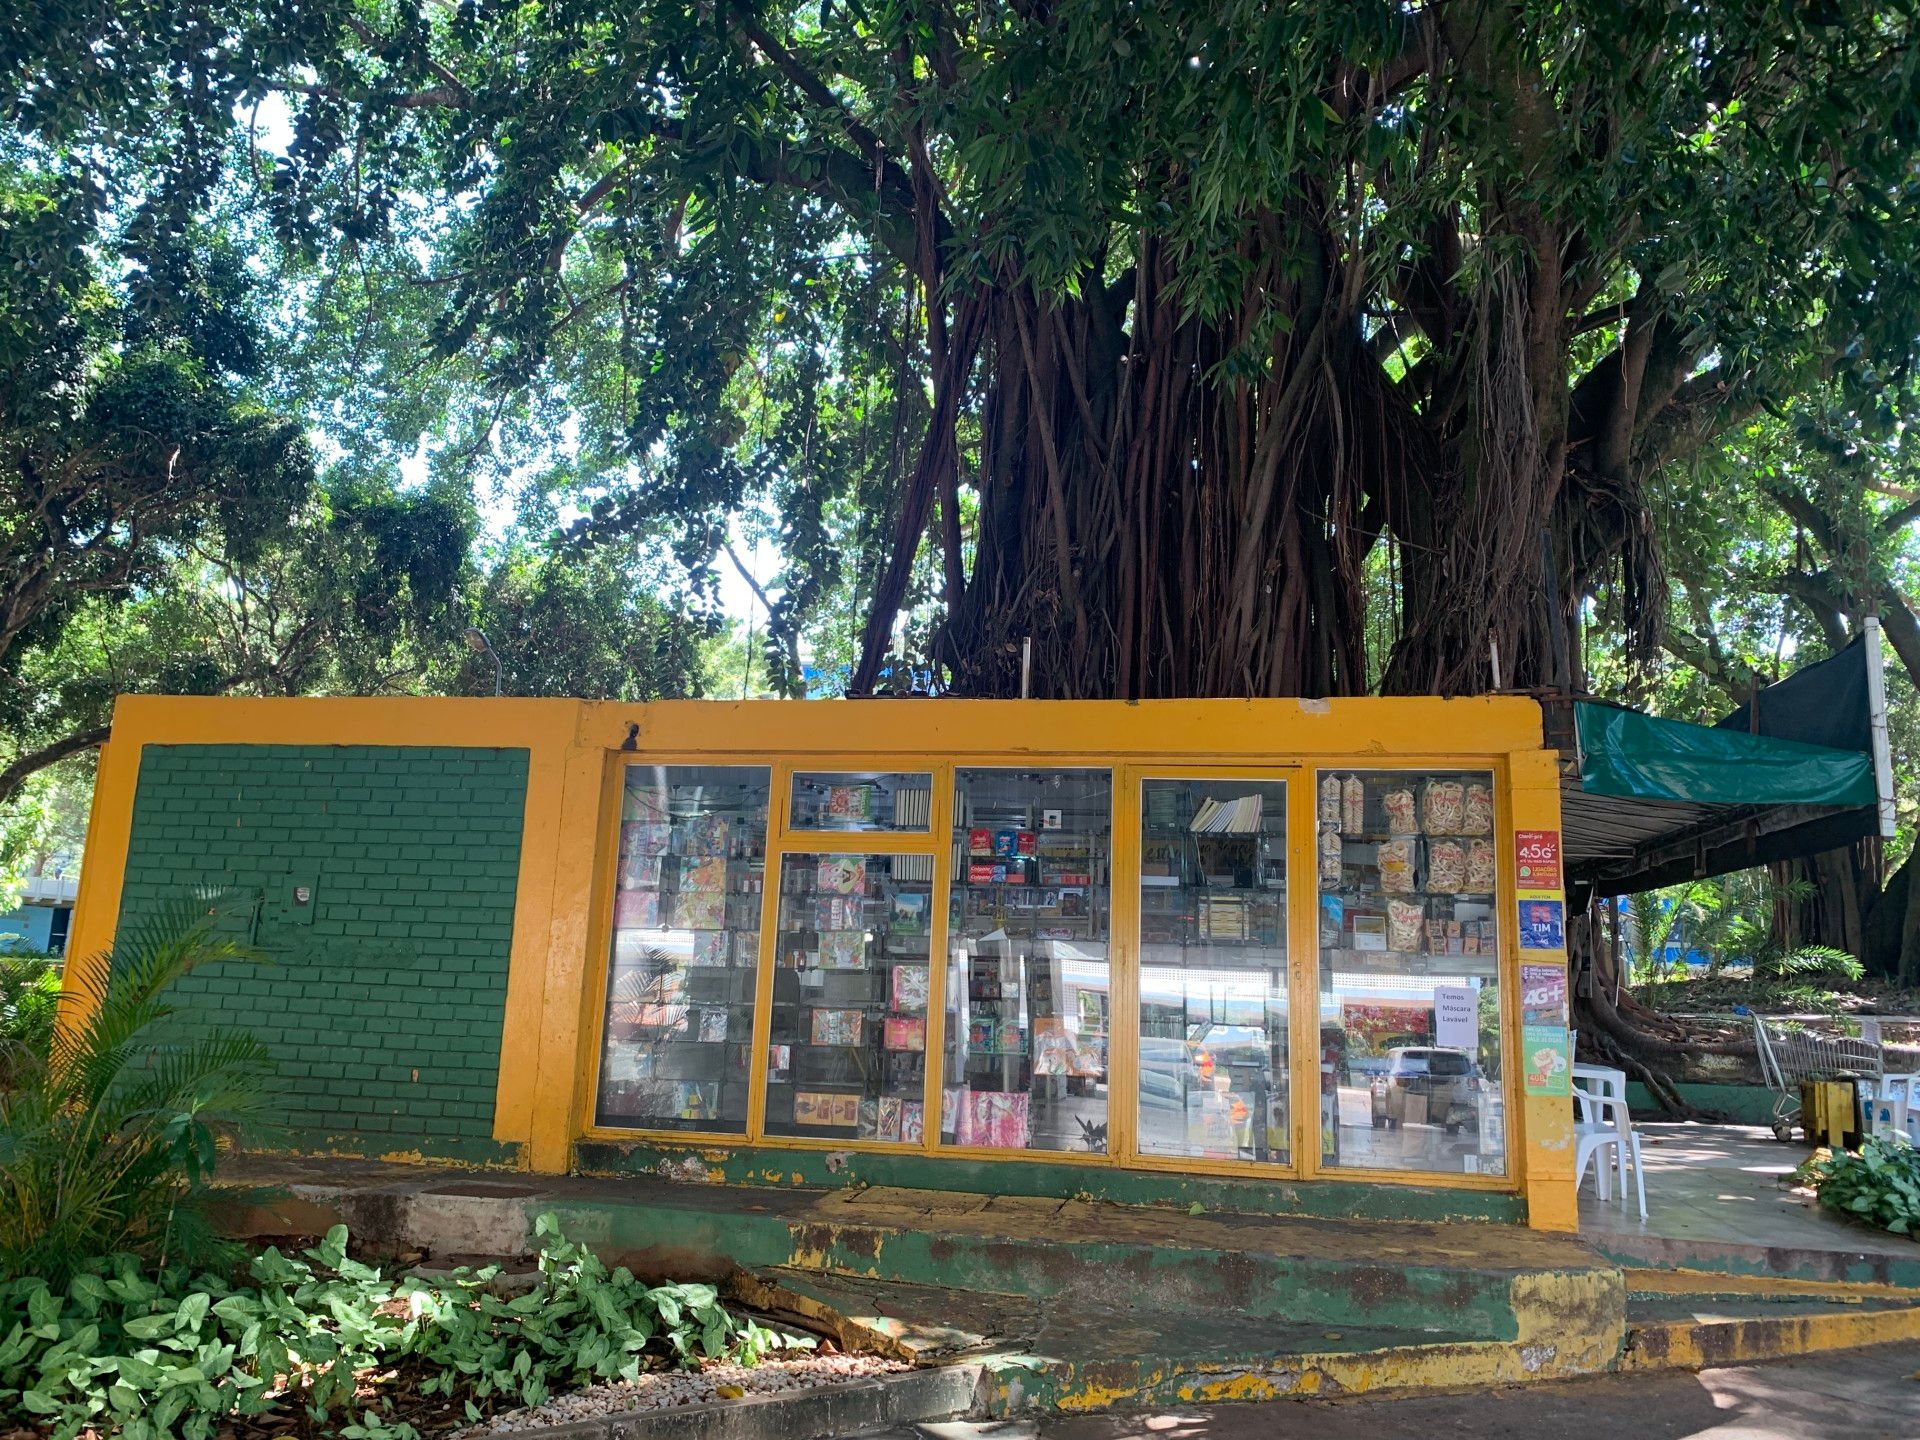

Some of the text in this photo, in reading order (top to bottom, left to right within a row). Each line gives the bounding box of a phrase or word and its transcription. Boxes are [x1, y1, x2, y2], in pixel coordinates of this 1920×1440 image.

[1520, 844, 1552, 859] 4.5G
[1532, 924, 1551, 932] TIM
[1524, 985, 1563, 1006] 4G+
